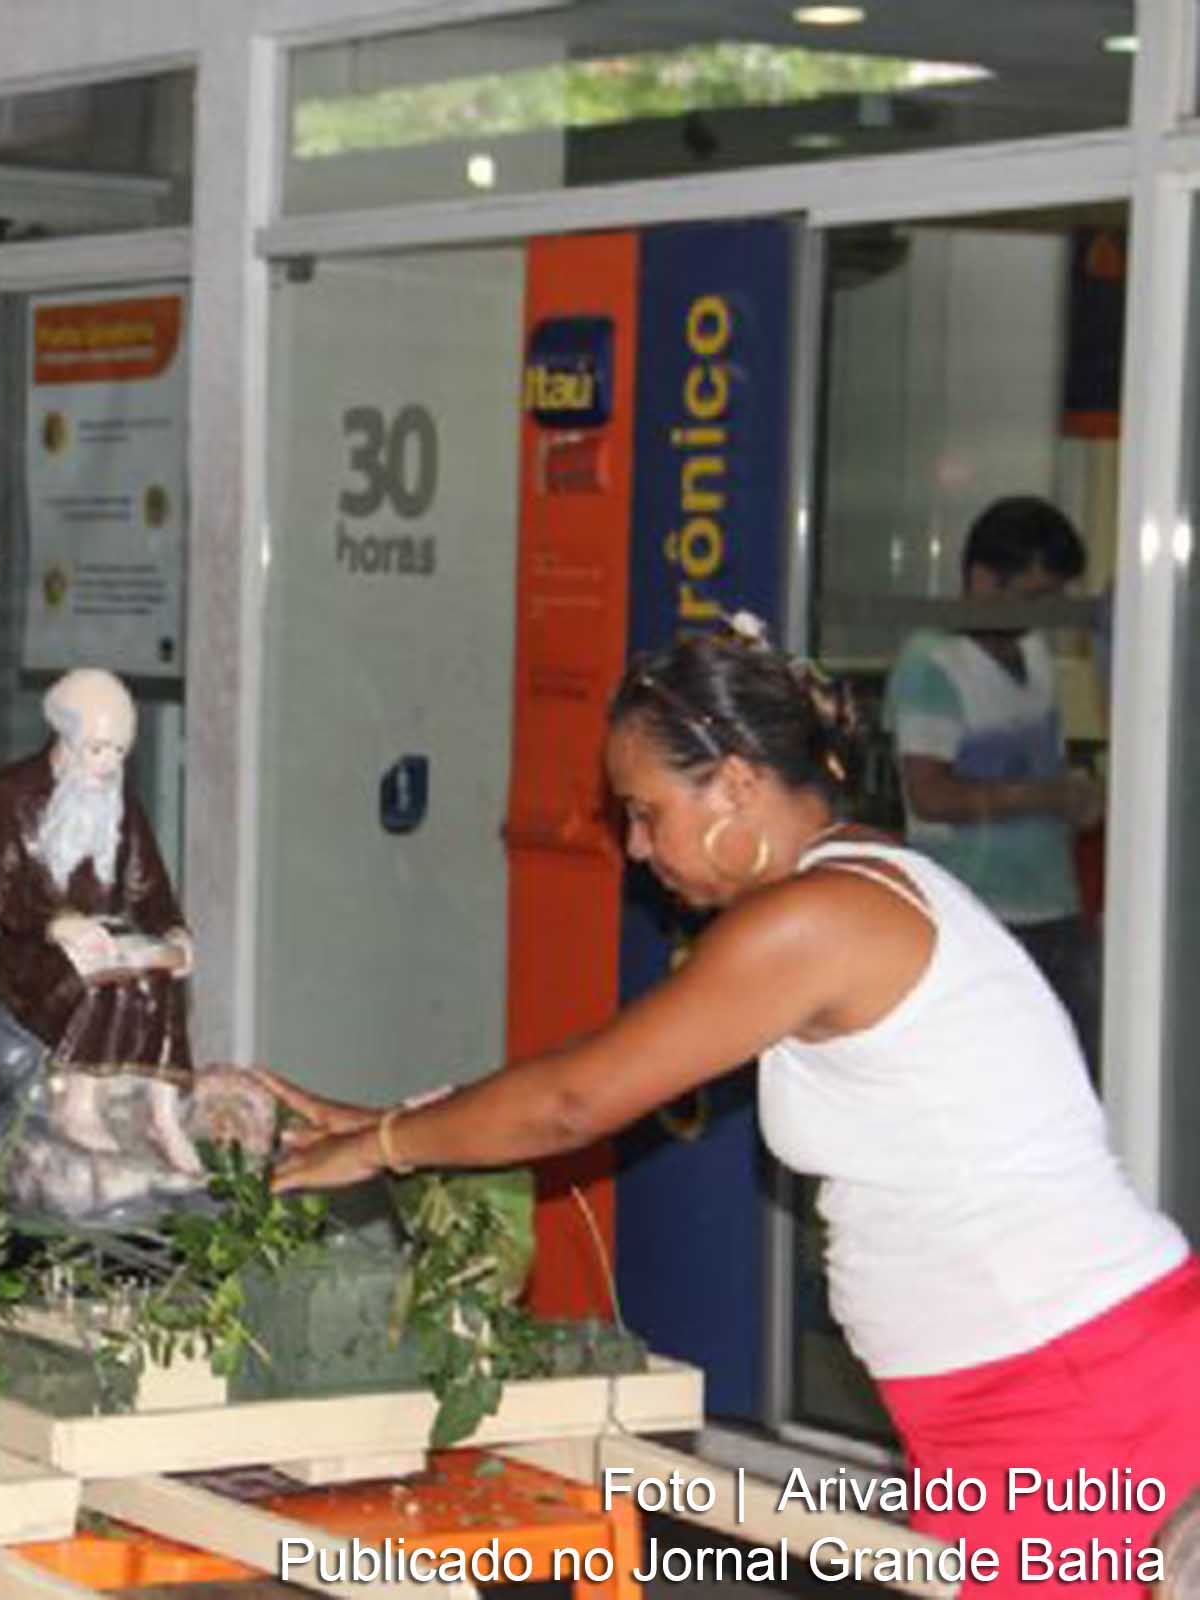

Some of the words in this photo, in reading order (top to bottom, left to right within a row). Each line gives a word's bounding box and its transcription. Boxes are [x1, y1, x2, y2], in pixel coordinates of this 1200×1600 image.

[521, 360, 594, 408] Itaú
[338, 404, 438, 519] 30
[665, 295, 730, 648] rônico
[336, 519, 437, 576] horas
